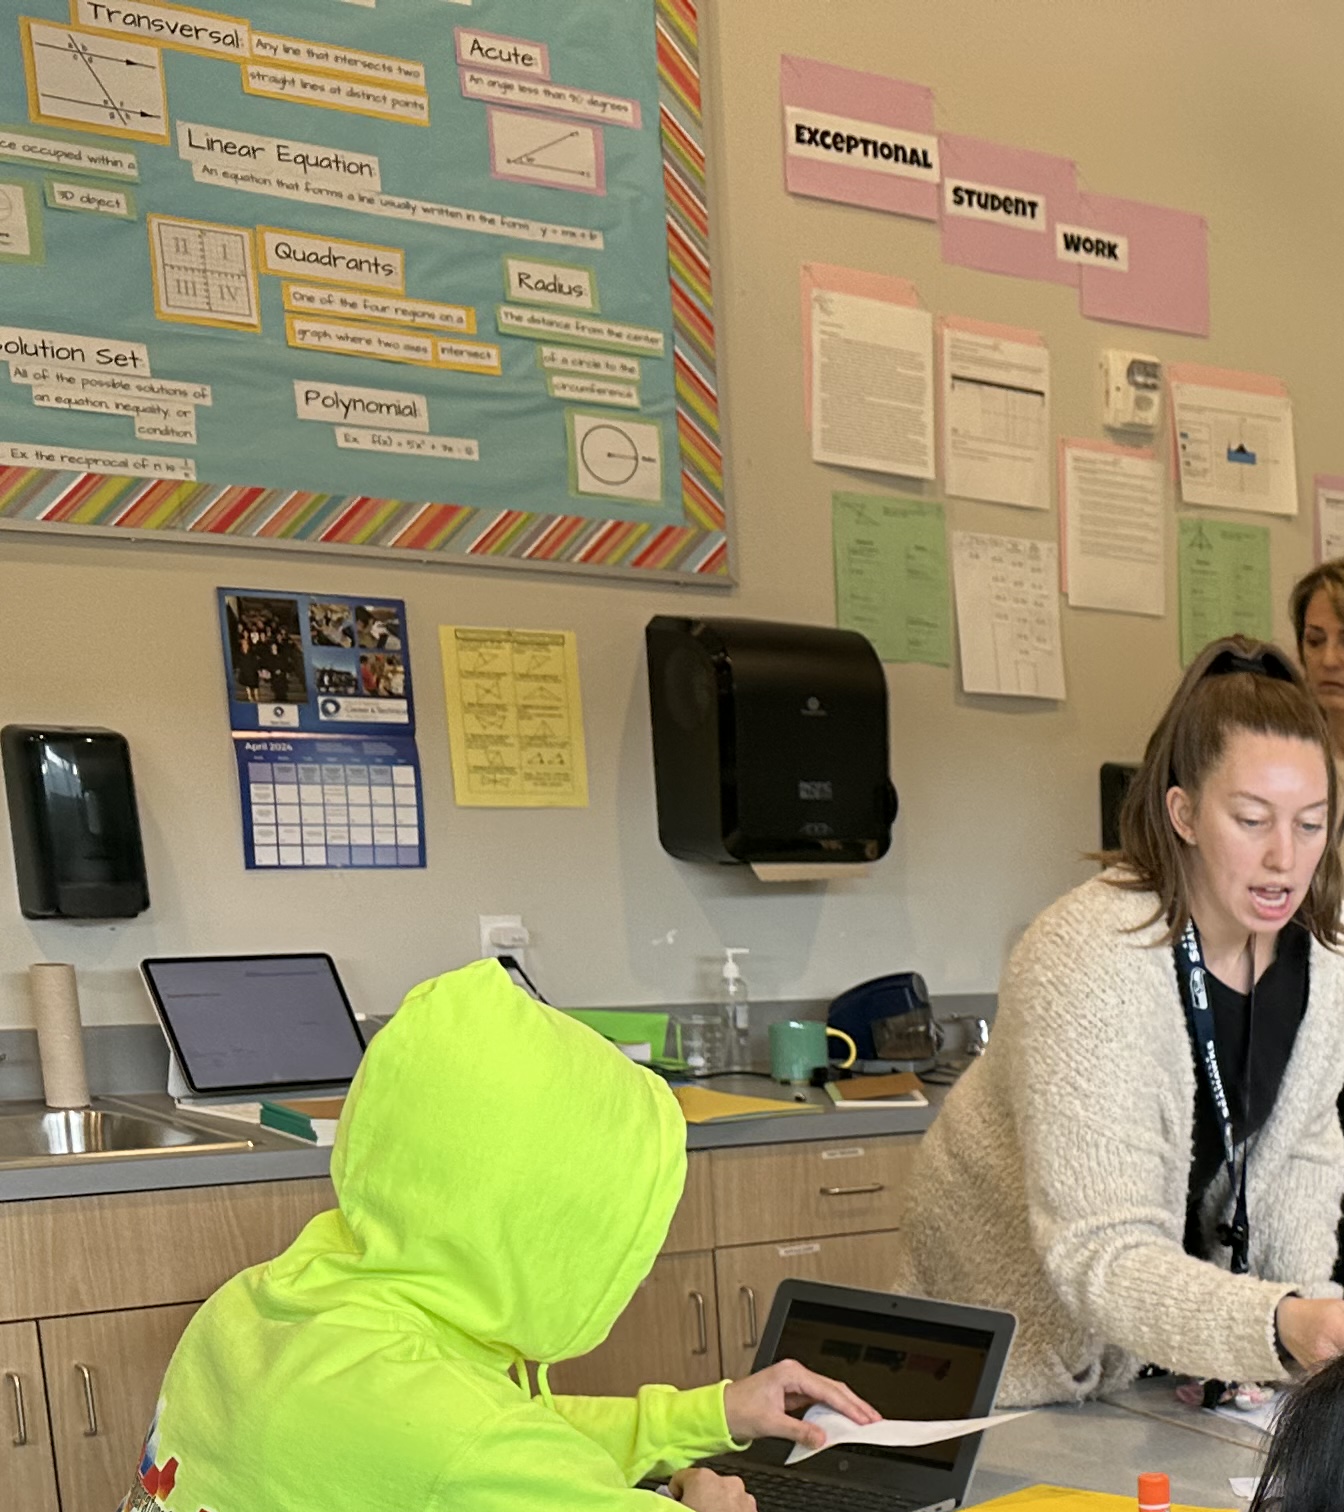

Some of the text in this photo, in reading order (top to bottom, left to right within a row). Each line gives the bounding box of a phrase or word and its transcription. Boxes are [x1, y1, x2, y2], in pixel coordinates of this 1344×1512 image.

[255, 38, 421, 78] Any line that intersects two
[250, 71, 425, 111] straight lines at distinct points
[469, 74, 484, 85] An
[487, 78, 514, 95] angle
[518, 82, 539, 96] less
[543, 87, 567, 100] than
[587, 97, 629, 113] degrees
[22, 144, 82, 162] occupied
[87, 155, 123, 168] within
[187, 127, 266, 160] Linear
[202, 164, 218, 177] An
[222, 171, 272, 186] equation
[276, 179, 299, 191] that
[304, 182, 343, 200] forms
[348, 192, 356, 201] a
[422, 206, 463, 220] written
[479, 213, 496, 226] the
[1062, 231, 1119, 261] WORK
[292, 290, 315, 303] One
[319, 294, 335, 305] of
[340, 297, 357, 309] the
[363, 299, 390, 313] four
[440, 313, 453, 323] on
[503, 310, 523, 323] The
[576, 321, 604, 335] from
[297, 327, 331, 342] graph
[336, 331, 372, 346] where
[378, 337, 400, 350] two
[14, 366, 209, 400] All of the possible solutions of
[34, 392, 50, 402] an
[176, 408, 192, 418] or
[138, 424, 193, 439] condition
[35, 450, 55, 463] the
[60, 455, 129, 470] reciprocal
[134, 458, 149, 470] of
